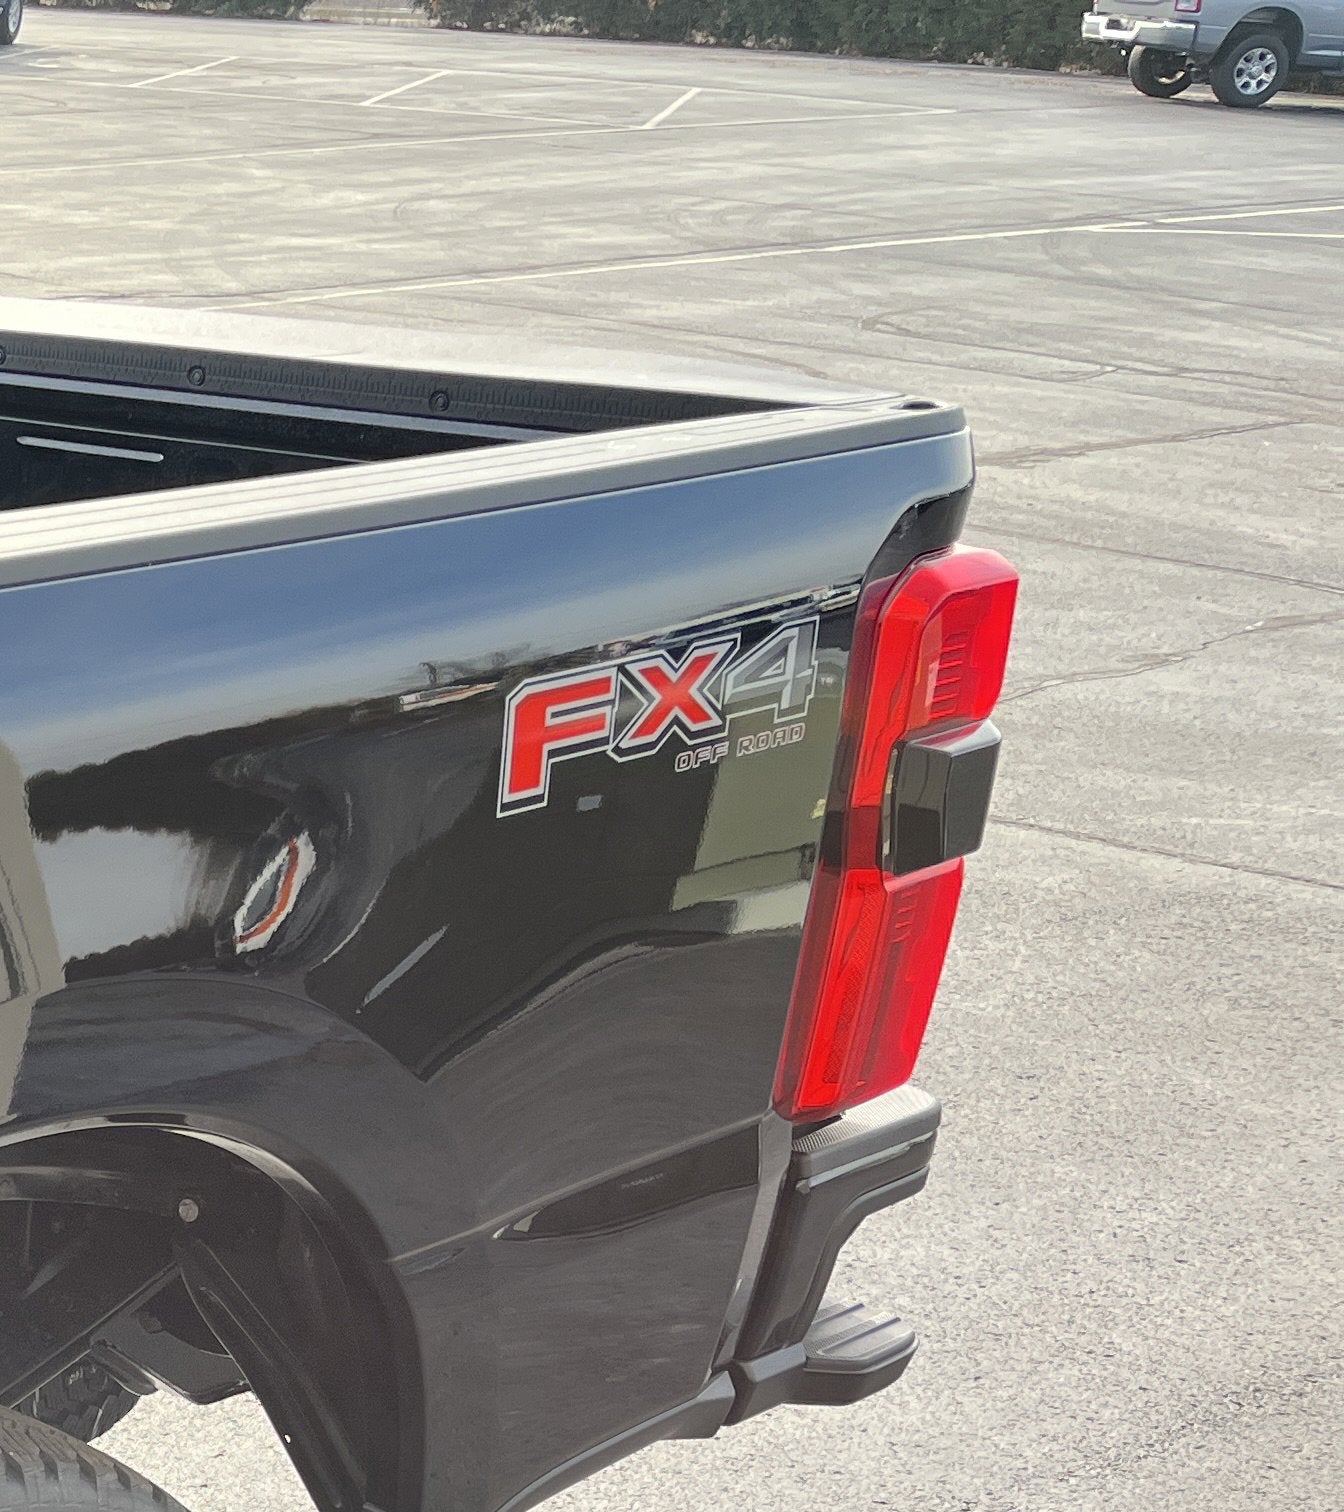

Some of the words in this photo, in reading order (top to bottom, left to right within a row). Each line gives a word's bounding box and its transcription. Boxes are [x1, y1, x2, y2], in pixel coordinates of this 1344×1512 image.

[496, 616, 820, 818] FX4
[674, 741, 729, 773] OFF
[736, 723, 806, 757] ROAD
